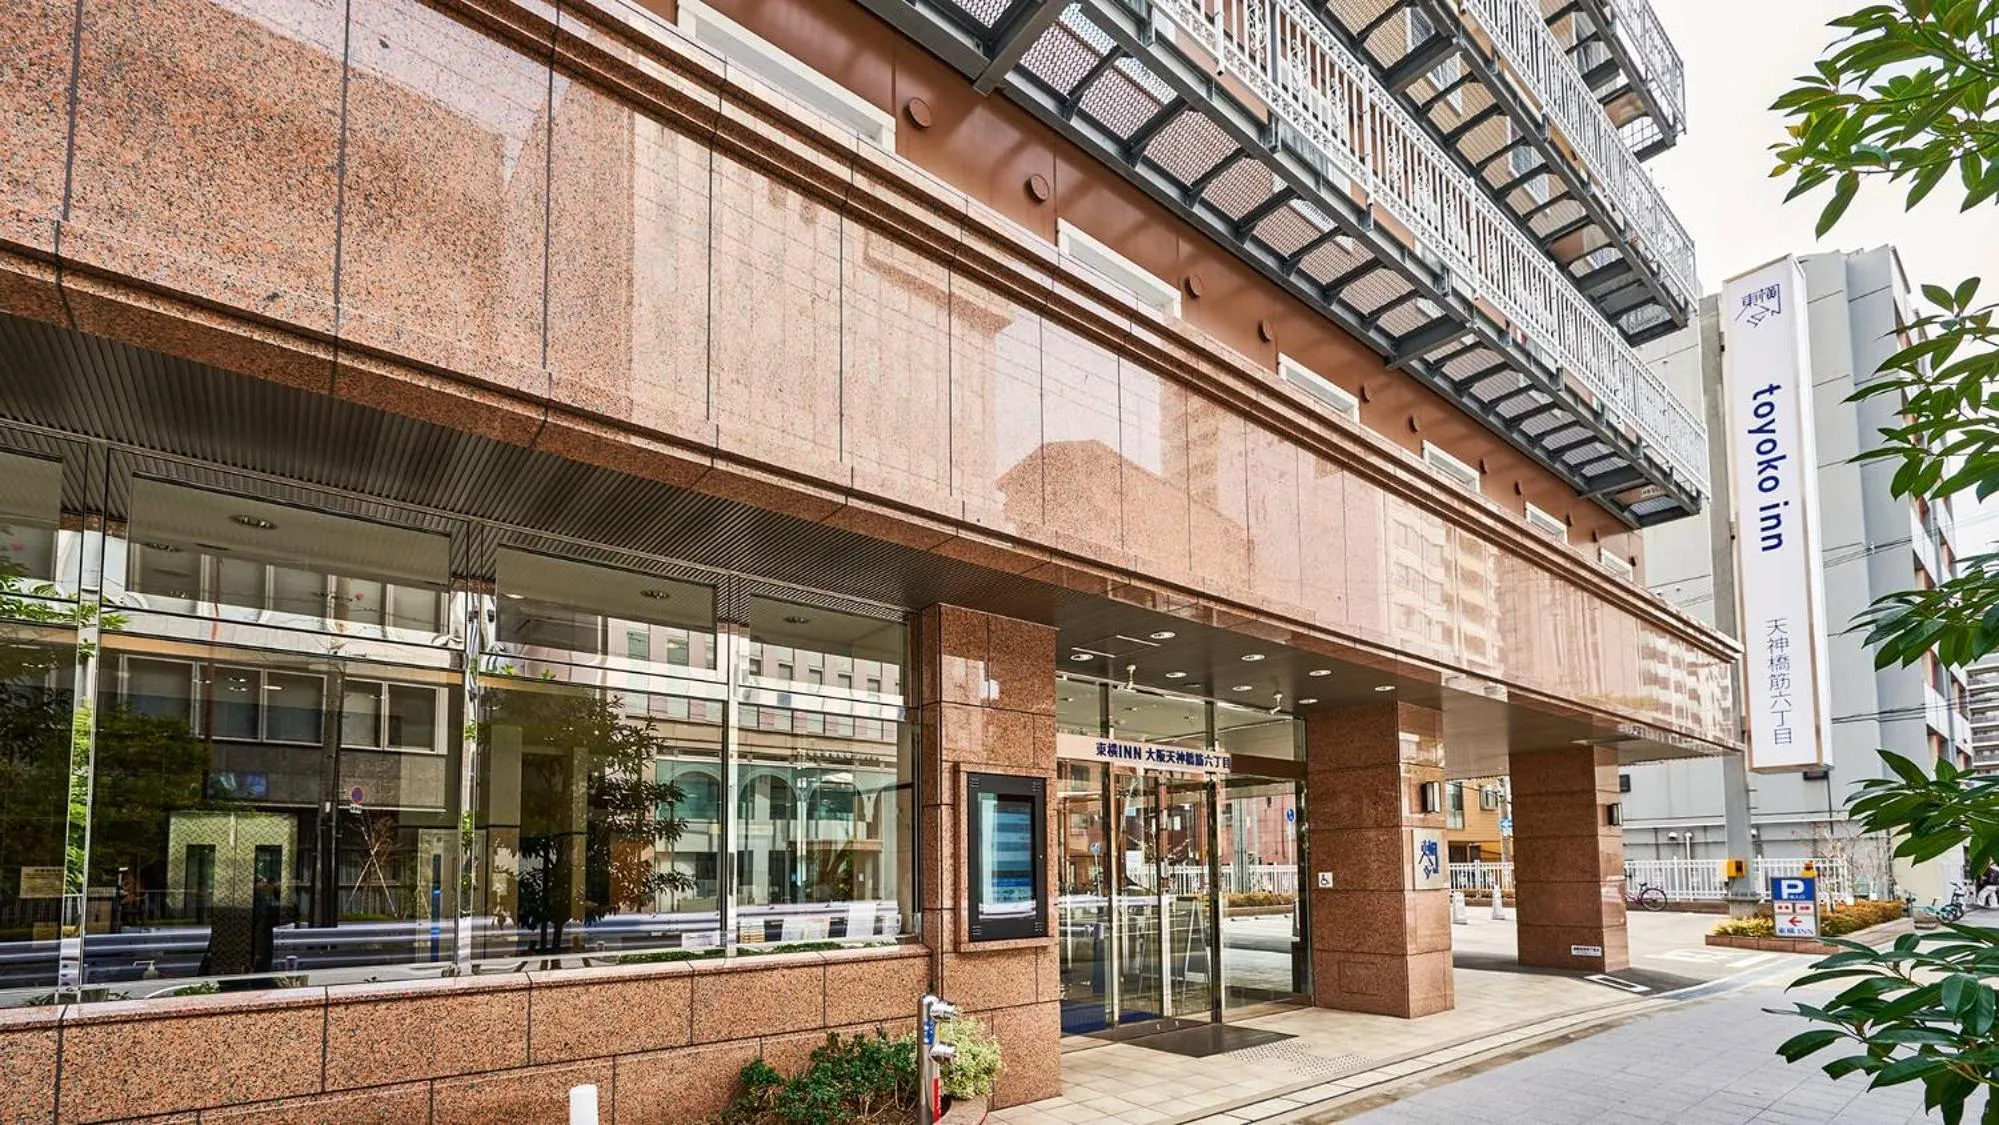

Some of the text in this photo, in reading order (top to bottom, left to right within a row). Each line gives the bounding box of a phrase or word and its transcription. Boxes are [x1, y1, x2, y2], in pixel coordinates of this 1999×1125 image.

[1748, 384, 1789, 552] toyoko inn
[1766, 618, 1792, 745] 天神橋筋六丁目
[1781, 880, 1805, 899] P
